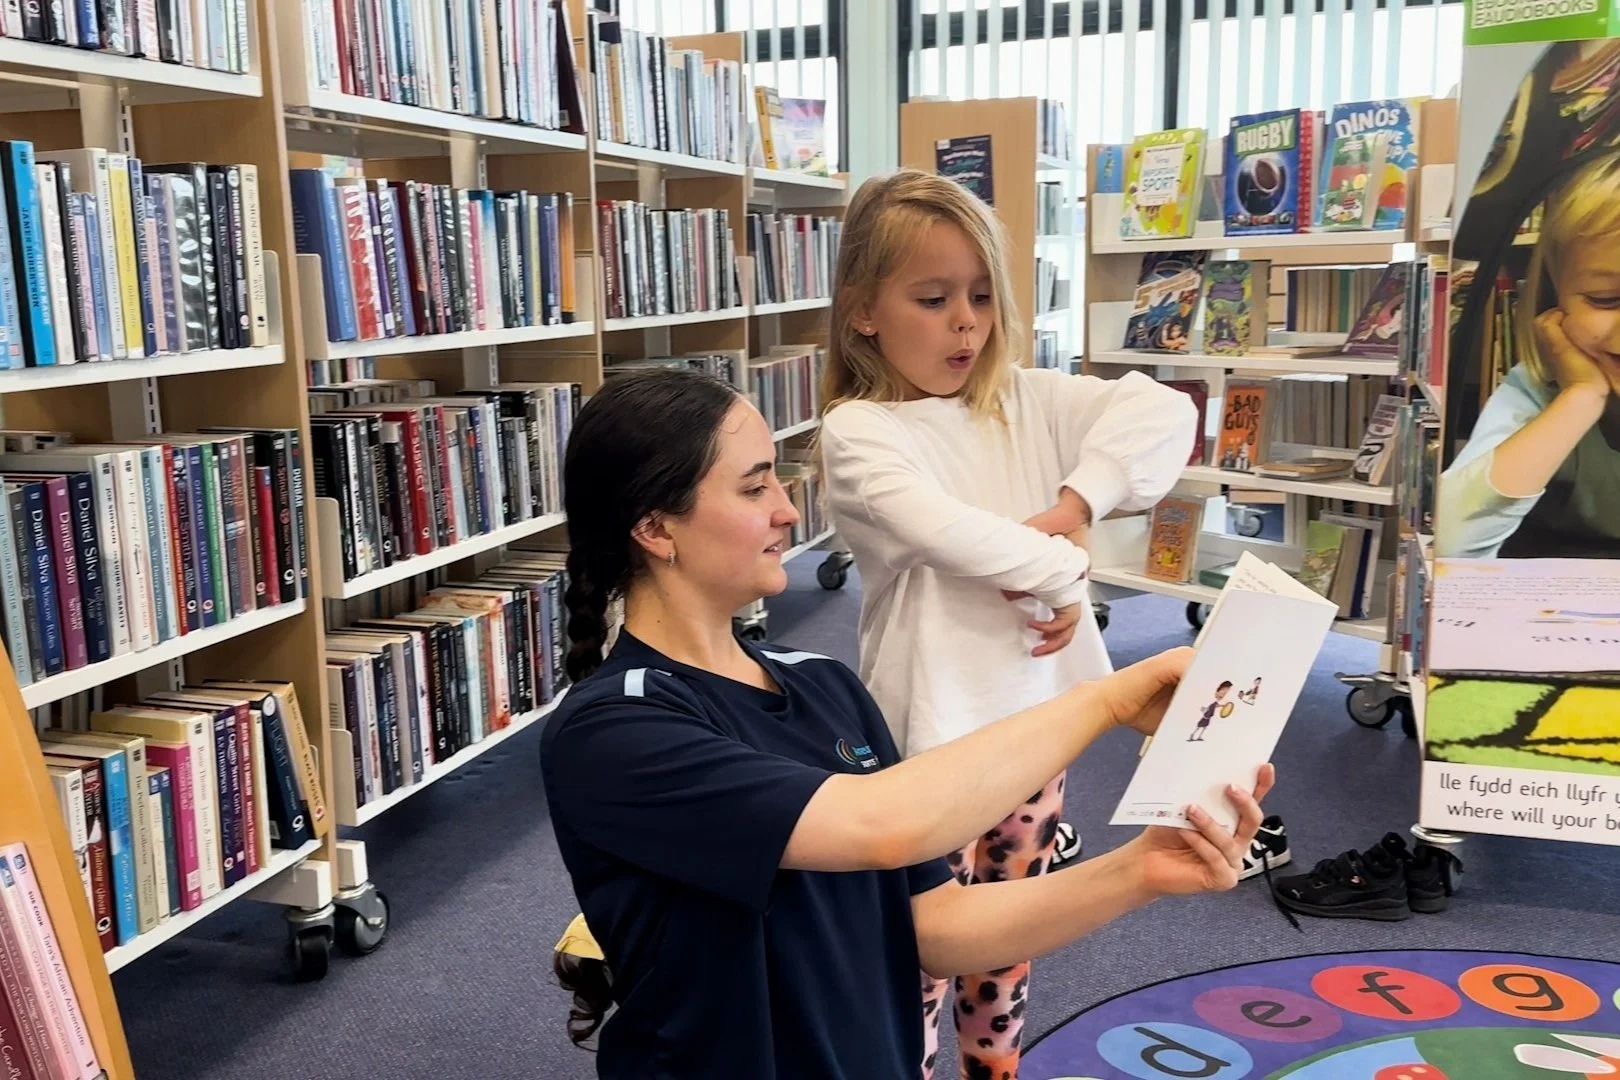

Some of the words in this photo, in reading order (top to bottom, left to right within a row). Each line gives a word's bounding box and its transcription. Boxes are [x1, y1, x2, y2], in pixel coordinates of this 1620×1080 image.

[1237, 119, 1293, 153] RUGBY
[1335, 108, 1399, 138] DINOS
[22, 207, 32, 243] JAMES
[232, 189, 241, 227] ROBERT
[219, 226, 228, 247] RYAN
[235, 230, 243, 256] RYAN
[25, 246, 39, 308] ROBERTSON
[36, 254, 47, 292] GIDEON
[40, 295, 50, 325] MACK
[1232, 395, 1260, 412] BAD
[1225, 413, 1259, 433] GUYS
[412, 437, 425, 492] SUSPECT
[144, 477, 152, 503] MAYA
[276, 468, 288, 505] Spindler
[293, 468, 302, 507] DUNBAR
[15, 520, 28, 551] Daniel
[31, 509, 47, 551] Daniel
[58, 511, 74, 552] Daniel
[77, 498, 93, 543] Daniel
[181, 521, 192, 561] Smith
[195, 499, 204, 530] TARGET
[202, 559, 210, 584] SMITH
[20, 553, 30, 577] Silva
[38, 555, 52, 584] Silva
[64, 555, 77, 585] Silva
[83, 547, 99, 581] Silva
[107, 504, 117, 545] SIMPSON
[116, 595, 125, 629] GRAVITY
[41, 586, 53, 621] Moscow
[68, 597, 78, 631] Servant
[46, 624, 57, 649] Rules
[433, 663, 442, 704] SEAGULL
[227, 733, 237, 765] Quality
[270, 718, 287, 768] FLIGHT
[218, 751, 228, 795] THOMPSON
[231, 766, 239, 791] Street
[241, 722, 249, 740] DEATH
[246, 801, 254, 827] Robert
[1440, 772, 1461, 791] lle
[1469, 776, 1512, 798] fydd
[1519, 781, 1558, 799] eich
[1567, 783, 1607, 806] llyfr
[85, 787, 94, 816] TAYLOR
[232, 793, 241, 814] Girls
[1447, 802, 1504, 820] where
[1511, 805, 1544, 824] will
[1552, 815, 1597, 830] your
[94, 845, 104, 882] Anatomy
[95, 888, 106, 915] Ghosts
[27, 891, 36, 904] SUE
[33, 906, 43, 927] COOK
[51, 962, 67, 995] African
[63, 997, 84, 1047] Adventure
[10, 984, 19, 998] THE
[1357, 971, 1413, 1015] f
[1494, 972, 1565, 1012] g
[1241, 1000, 1311, 1029] e
[39, 1029, 49, 1050] Heart
[1133, 1026, 1231, 1078] d
